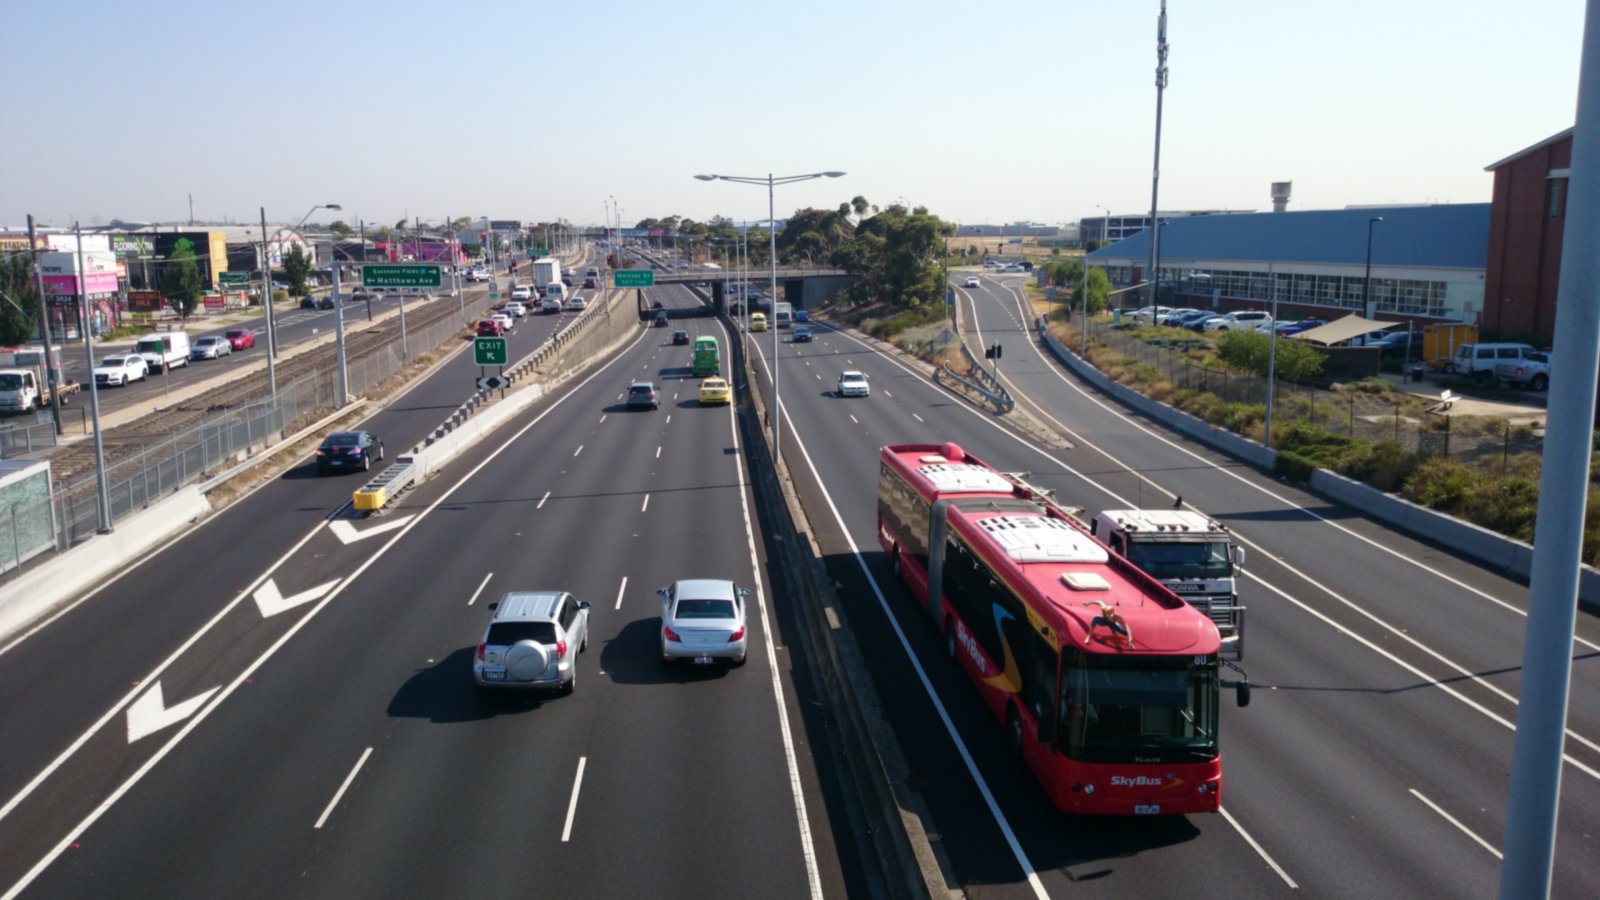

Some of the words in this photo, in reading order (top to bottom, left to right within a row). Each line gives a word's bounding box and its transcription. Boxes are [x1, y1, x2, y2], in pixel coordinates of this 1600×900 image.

[479, 341, 502, 350] EXIT
[957, 620, 986, 674] SkyBus
[1110, 775, 1162, 788] SkyBus
